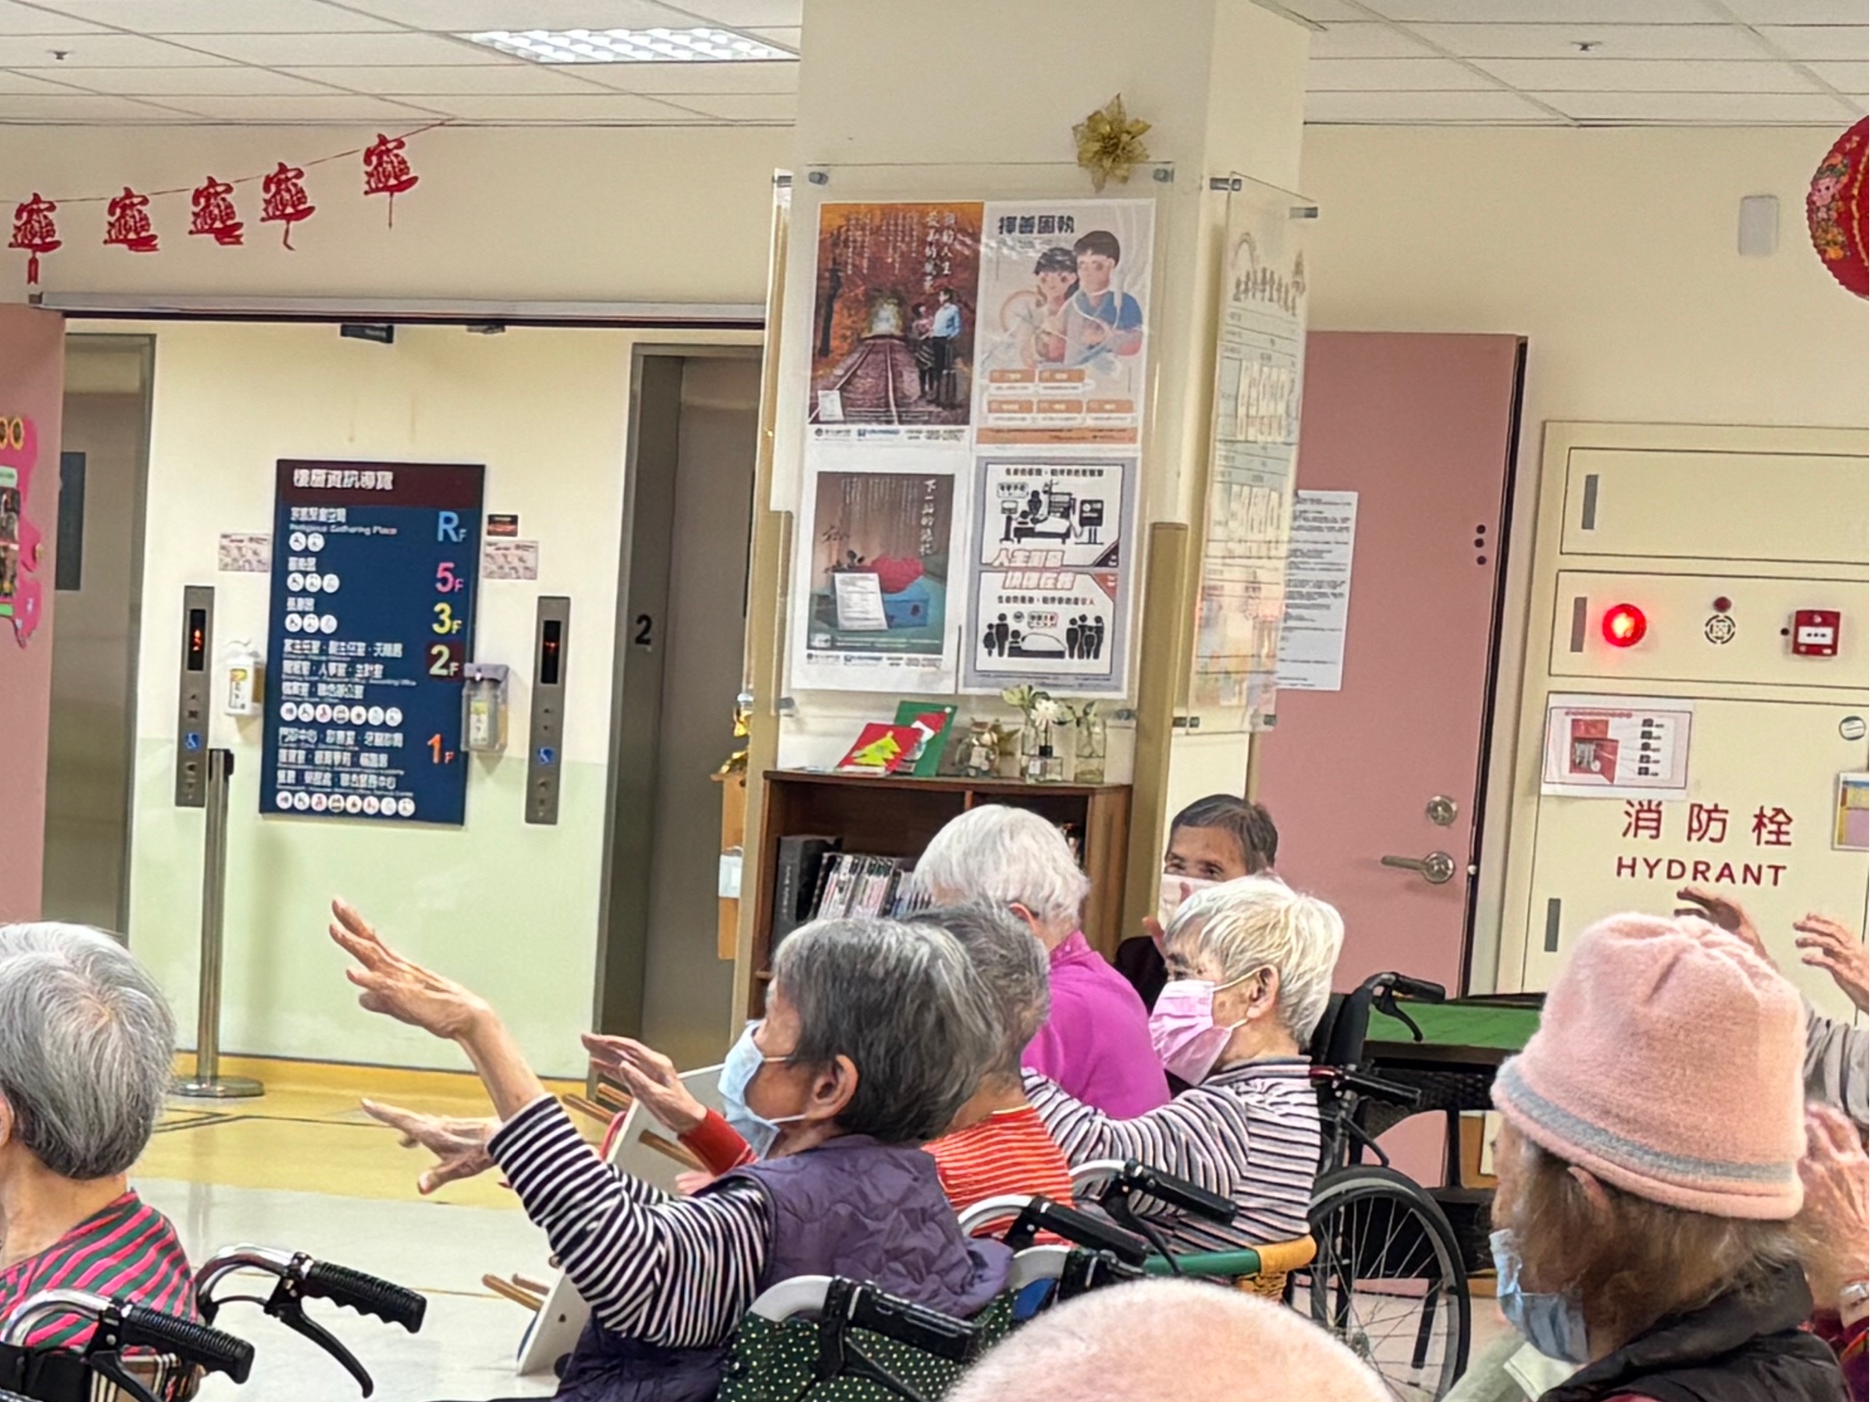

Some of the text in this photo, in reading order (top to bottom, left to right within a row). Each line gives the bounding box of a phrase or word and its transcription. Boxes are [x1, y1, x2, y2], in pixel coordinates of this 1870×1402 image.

[635, 614, 652, 645] 2
[1621, 799, 1793, 847] 消防栓
[1616, 855, 1787, 887] HYDRANT
